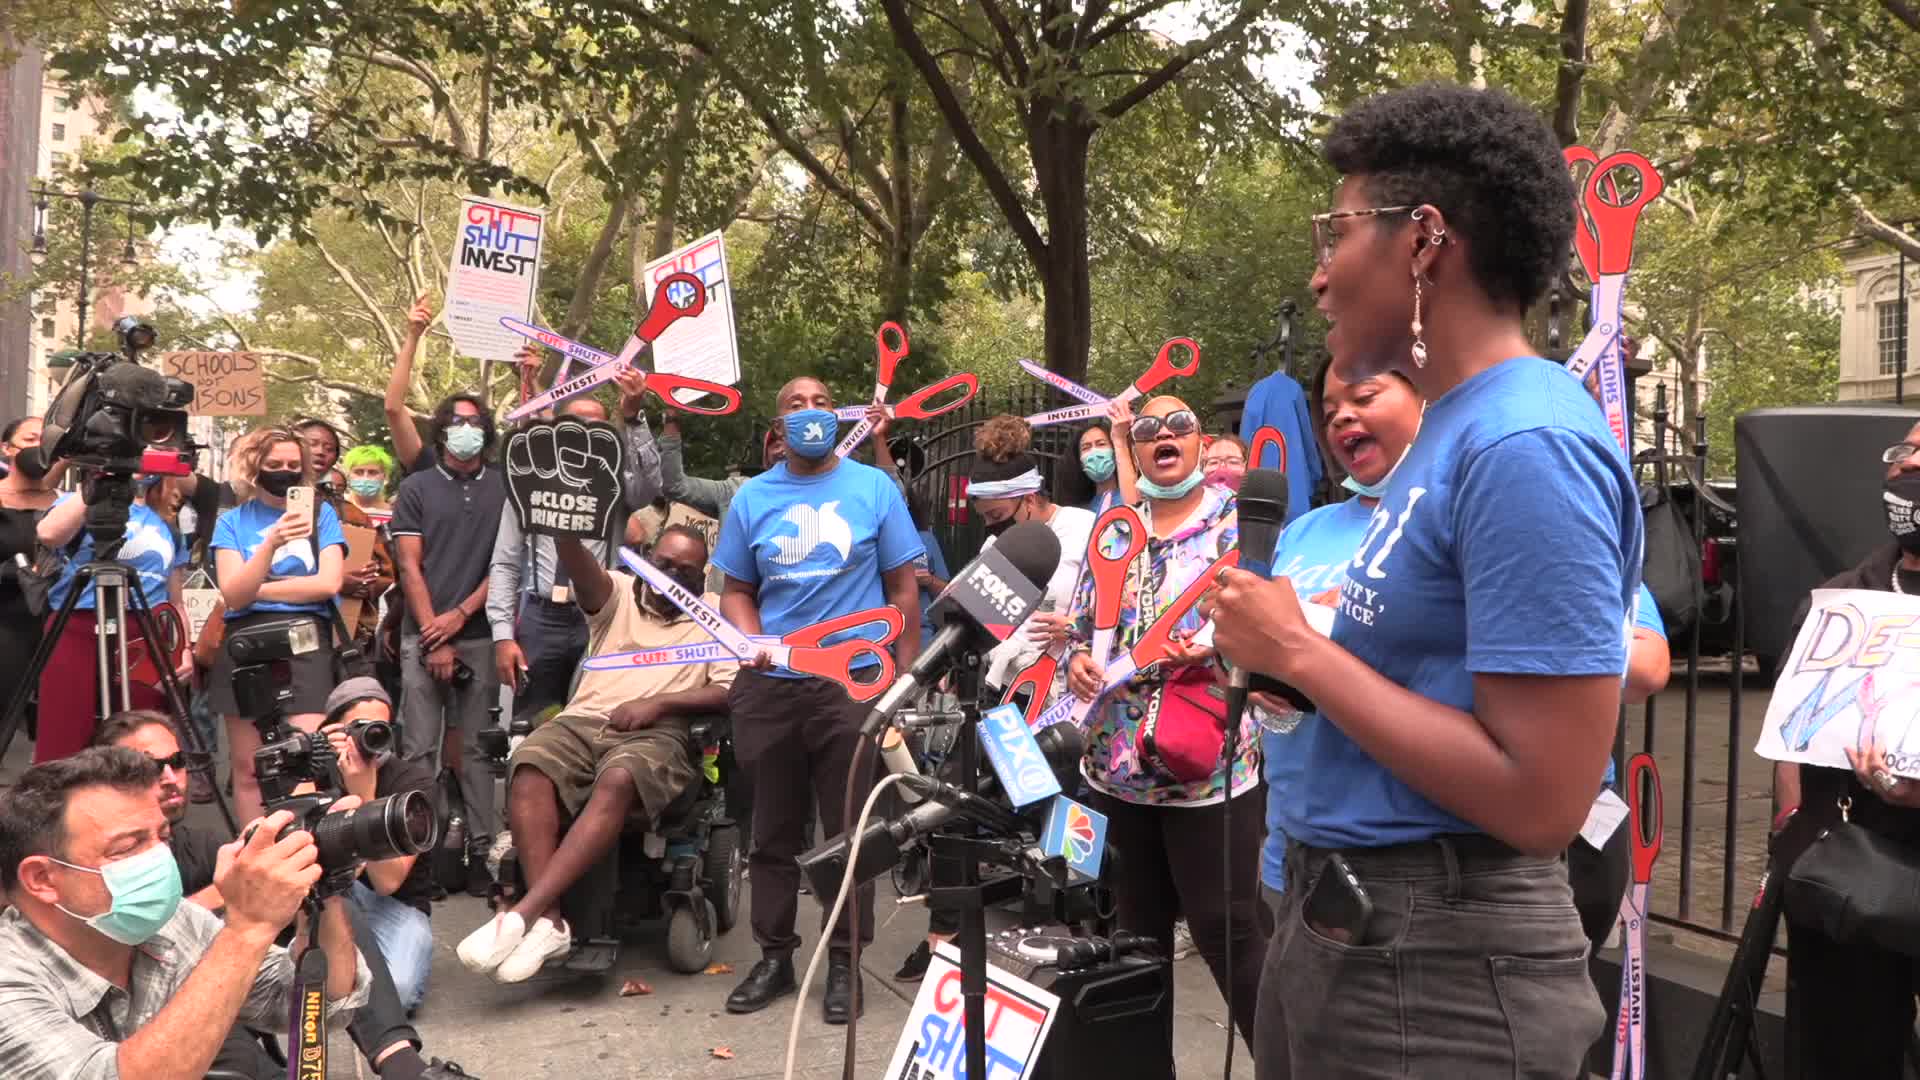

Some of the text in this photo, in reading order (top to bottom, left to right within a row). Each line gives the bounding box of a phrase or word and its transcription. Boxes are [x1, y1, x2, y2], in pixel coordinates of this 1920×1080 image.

[467, 204, 541, 231] CUT
[465, 221, 538, 253] SHUT
[460, 238, 536, 276] INVEST
[168, 353, 257, 376] SCHOOLS
[568, 344, 601, 363] SHUT!
[550, 373, 598, 400] INVEST!
[1601, 354, 1618, 403] SHUT!
[190, 387, 262, 411] ISONS
[1047, 408, 1090, 421] INVEST!
[843, 423, 868, 450] INVEST!
[530, 490, 599, 513] #CLOSE
[531, 507, 595, 531] RIKERS
[667, 584, 721, 631] INVEST!
[632, 646, 720, 664] CUT! SHUT!
[1143, 687, 1161, 737] YORK
[987, 706, 1040, 769] PIX
[1631, 957, 1640, 1026] INVEST!
[304, 992, 320, 1043] Nikon
